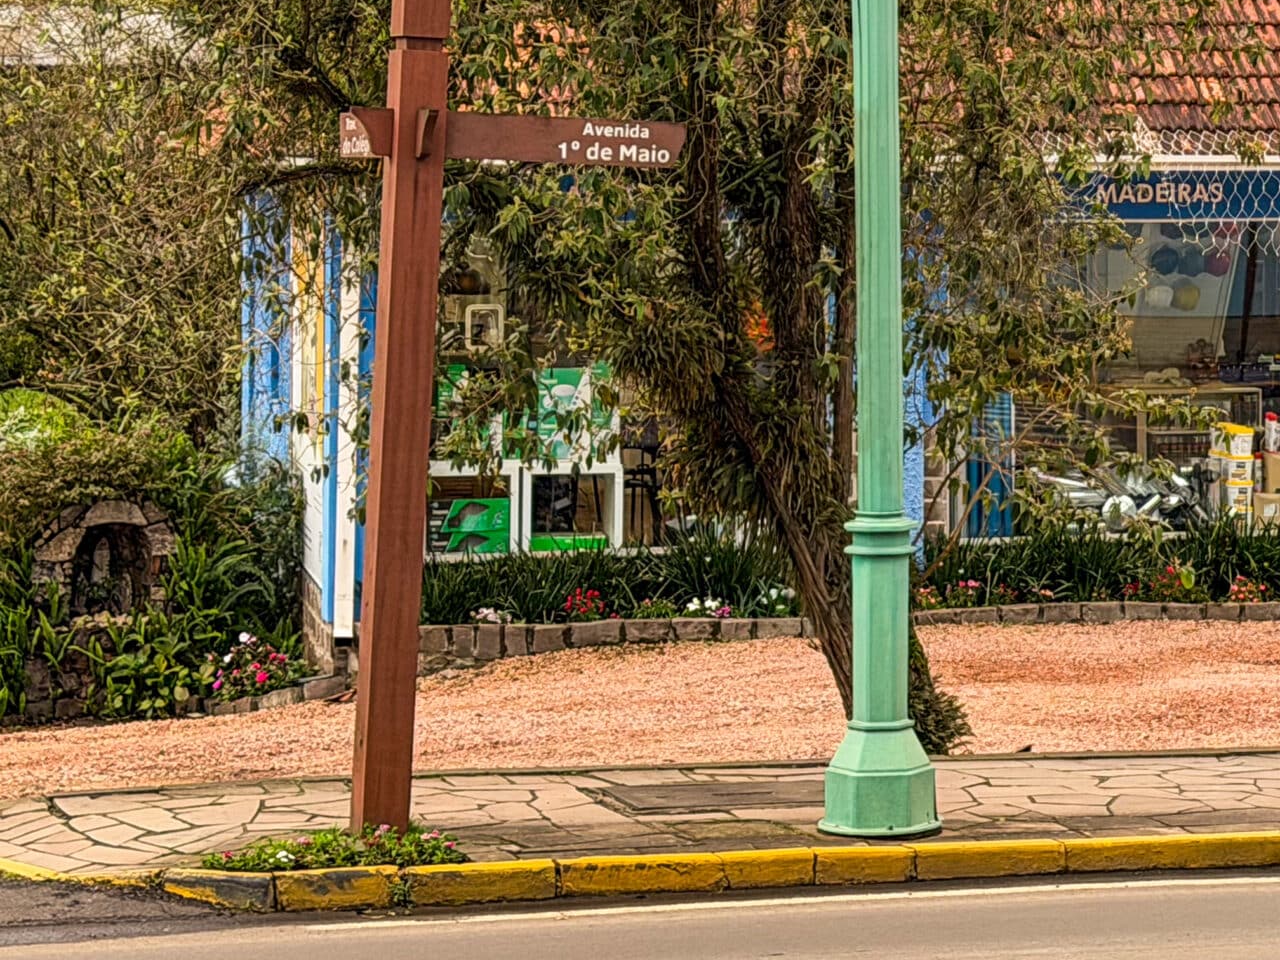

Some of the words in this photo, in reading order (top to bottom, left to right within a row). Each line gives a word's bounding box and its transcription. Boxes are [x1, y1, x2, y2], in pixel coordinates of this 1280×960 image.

[582, 122, 650, 139] Avenida
[586, 142, 613, 161] de
[619, 144, 671, 163] Maio
[1098, 182, 1224, 204] MADEIRAS
